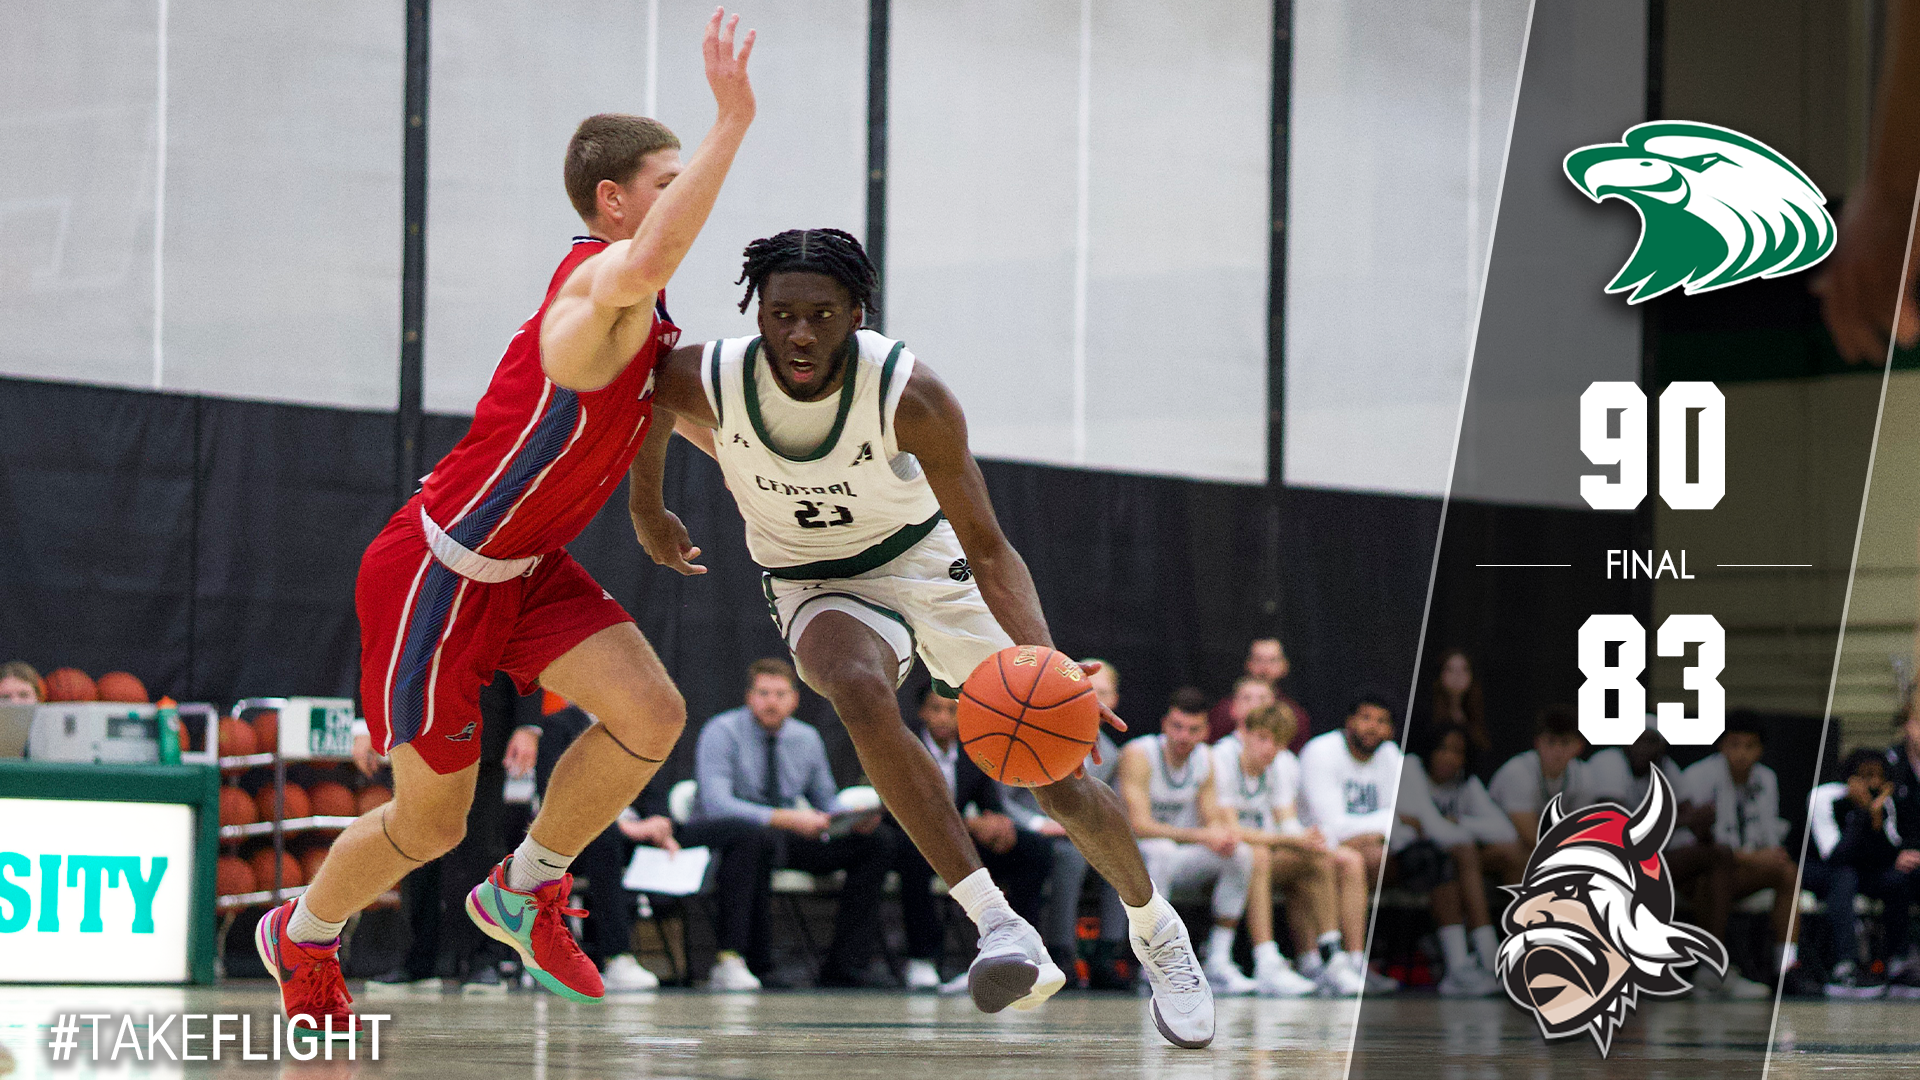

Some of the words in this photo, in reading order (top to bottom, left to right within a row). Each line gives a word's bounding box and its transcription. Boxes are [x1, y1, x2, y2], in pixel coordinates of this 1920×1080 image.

[755, 475, 858, 498] CENTRAL
[794, 500, 854, 528] 23
[0, 851, 168, 934] SITY
